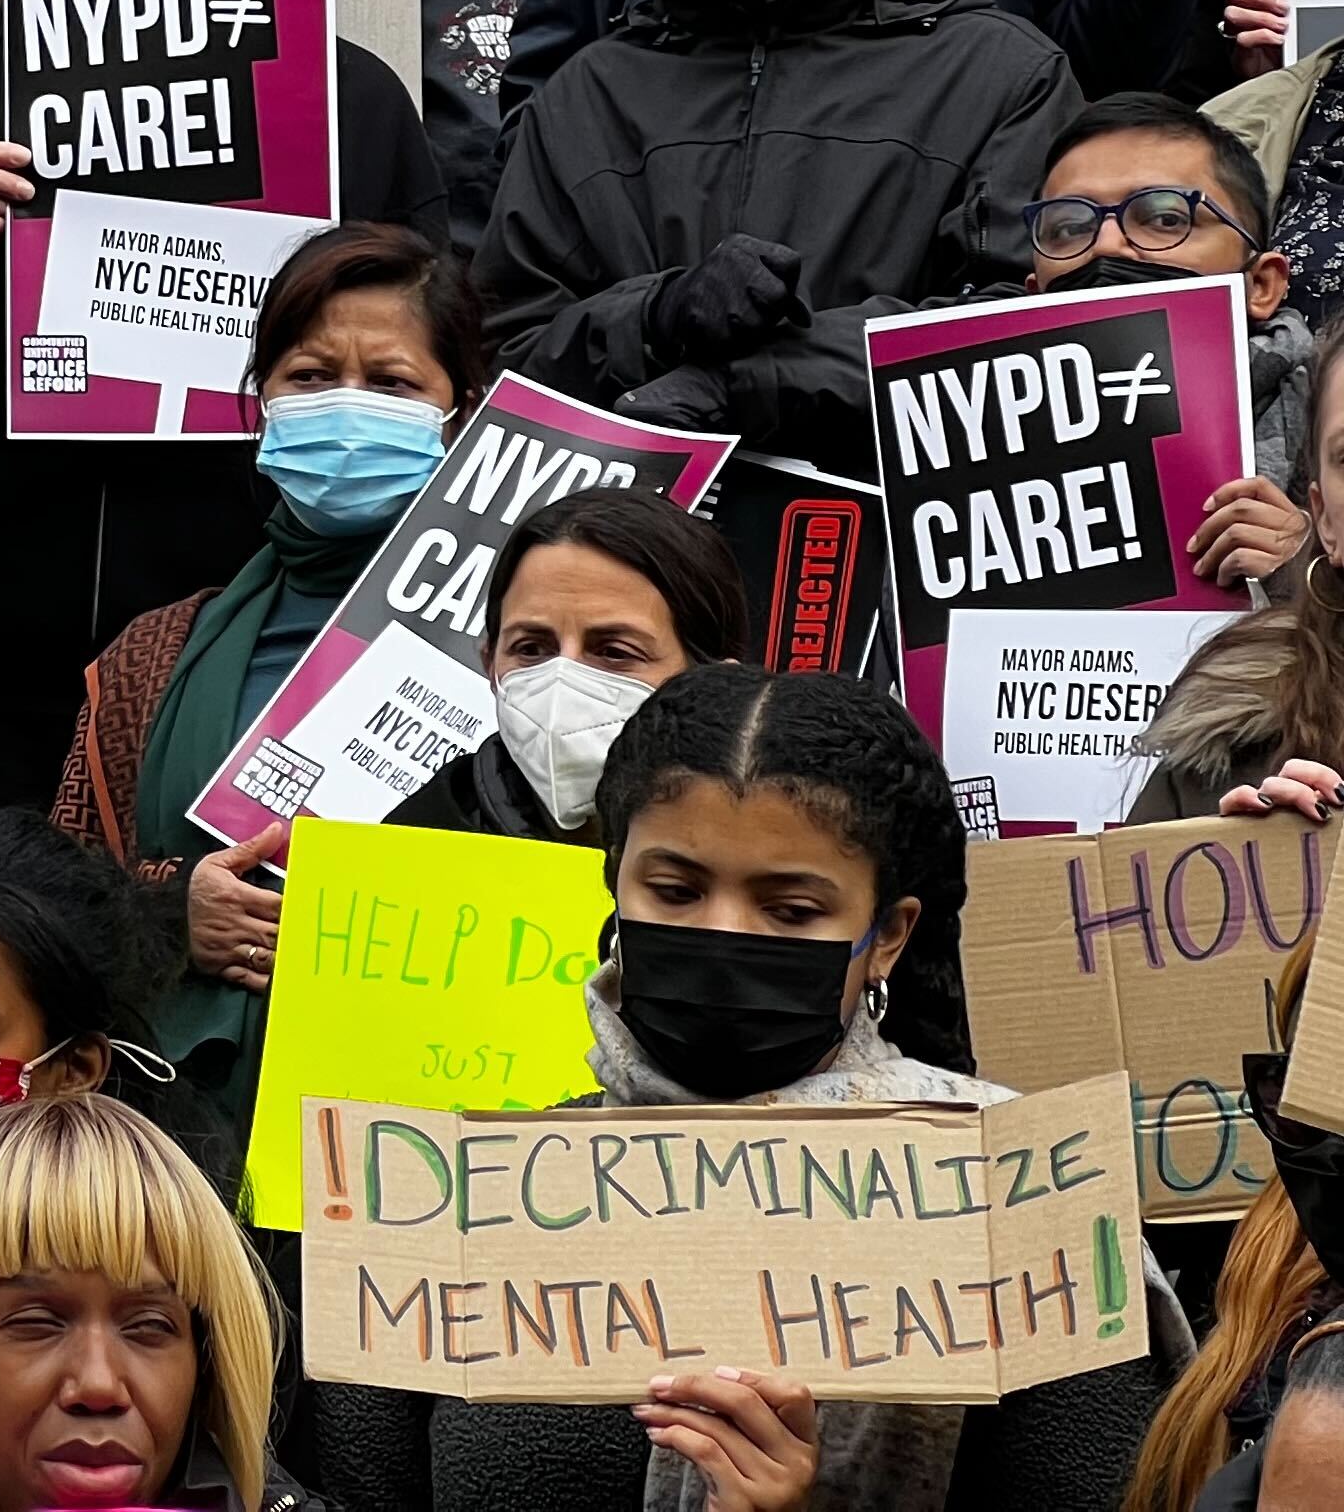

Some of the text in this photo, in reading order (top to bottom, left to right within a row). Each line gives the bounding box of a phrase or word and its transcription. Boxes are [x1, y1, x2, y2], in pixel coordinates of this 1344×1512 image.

[28, 77, 234, 179] CARE!
[101, 229, 225, 264] MAYOR ADAMS,
[95, 257, 273, 309] NYC DESERV
[90, 300, 211, 333] PUBLIC HEALTH
[23, 360, 85, 377] POLICE
[23, 377, 86, 392] REFORM
[913, 462, 1143, 600] CARE!
[1001, 649, 1138, 677] MAYOR ADAMS,
[396, 676, 447, 718] MAYOR
[996, 681, 1057, 720] NYC
[365, 701, 422, 751] NYC
[994, 732, 1053, 755] PUBLIC
[1058, 733, 1125, 757] HEALTH
[342, 738, 392, 779] PUBLIC
[314, 887, 480, 990] HELP
[421, 1043, 518, 1085] JUST
[358, 1265, 706, 1367] MENTAL
